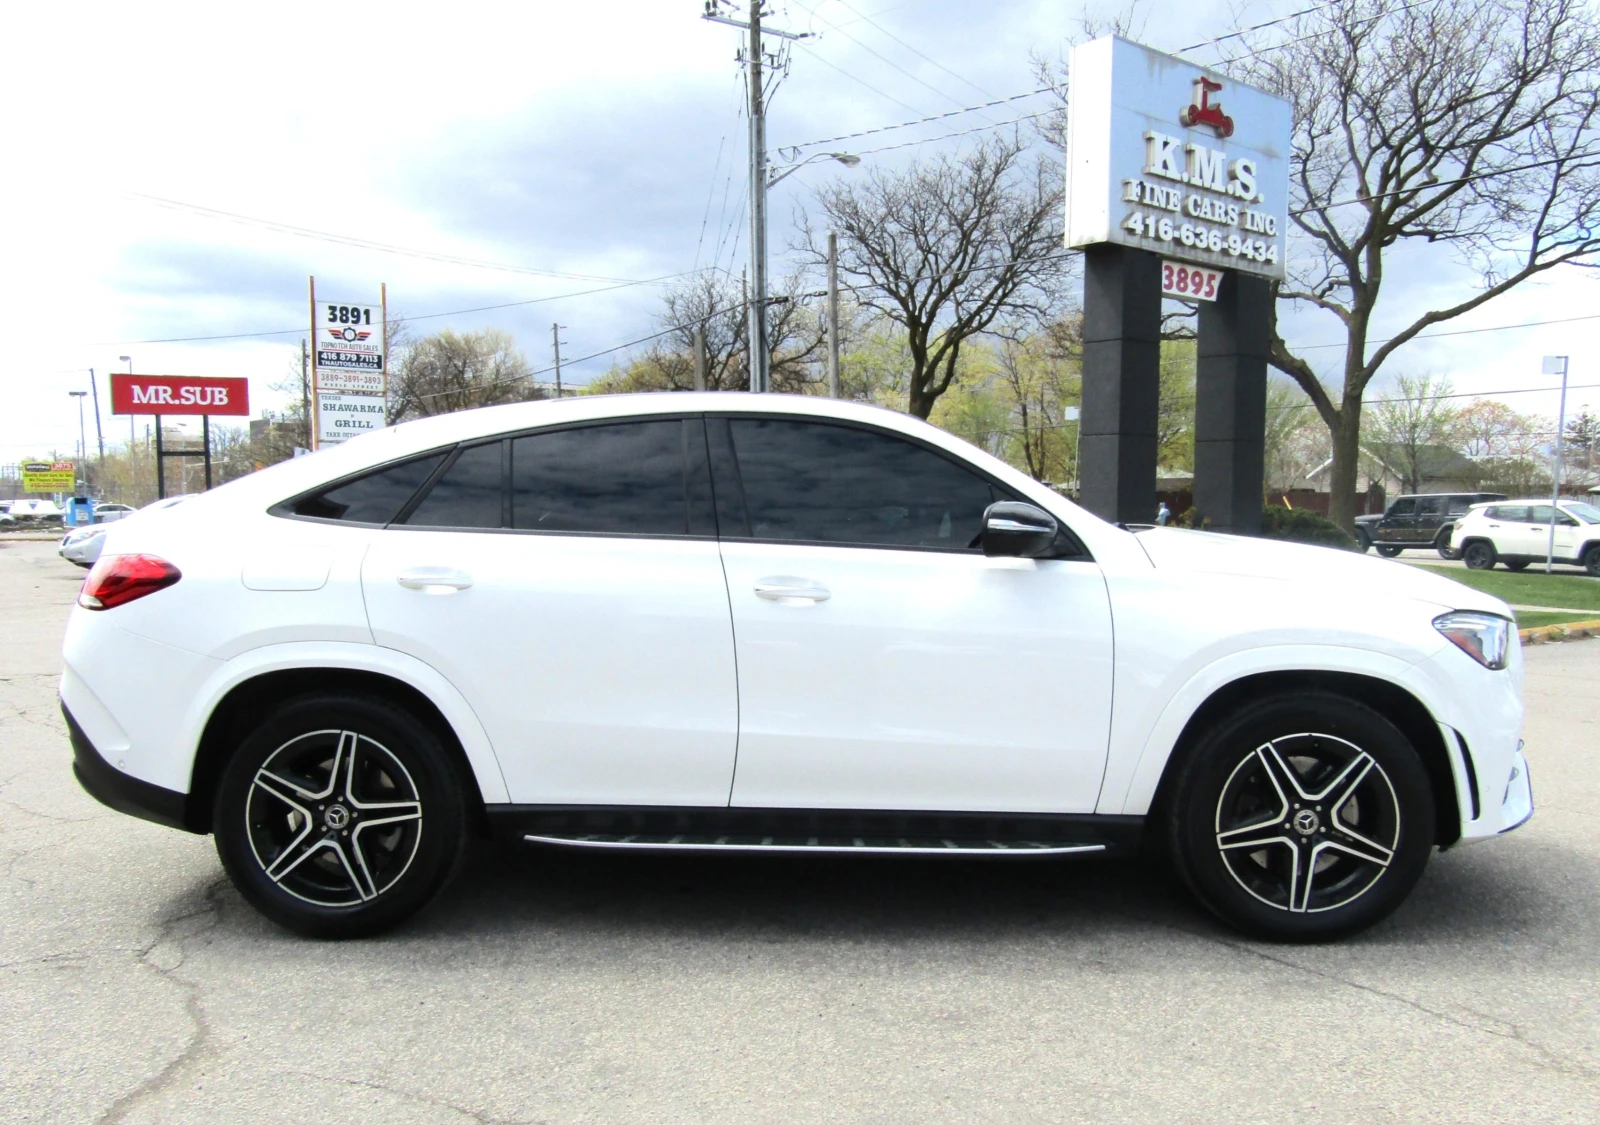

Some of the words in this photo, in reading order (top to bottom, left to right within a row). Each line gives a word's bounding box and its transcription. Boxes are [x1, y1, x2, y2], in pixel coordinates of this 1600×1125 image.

[1145, 130, 1265, 204] K.M.S.
[1125, 178, 1181, 212] FINE
[1186, 194, 1239, 226] CARS
[1242, 208, 1279, 237] INC.
[1125, 211, 1279, 265] 416-636-9434
[1163, 264, 1216, 298] 3895
[328, 305, 371, 325] 3891
[363, 344, 378, 352] SALES
[321, 352, 337, 360] 416
[339, 353, 357, 361] 879
[359, 354, 379, 363] 7113
[321, 360, 378, 369] TNAUTOSALES.CA
[321, 373, 381, 385] 3889-3891-3893
[131, 384, 229, 405] MR.SUB
[322, 403, 384, 413] SHAWARMA
[334, 419, 374, 429] GRILL
